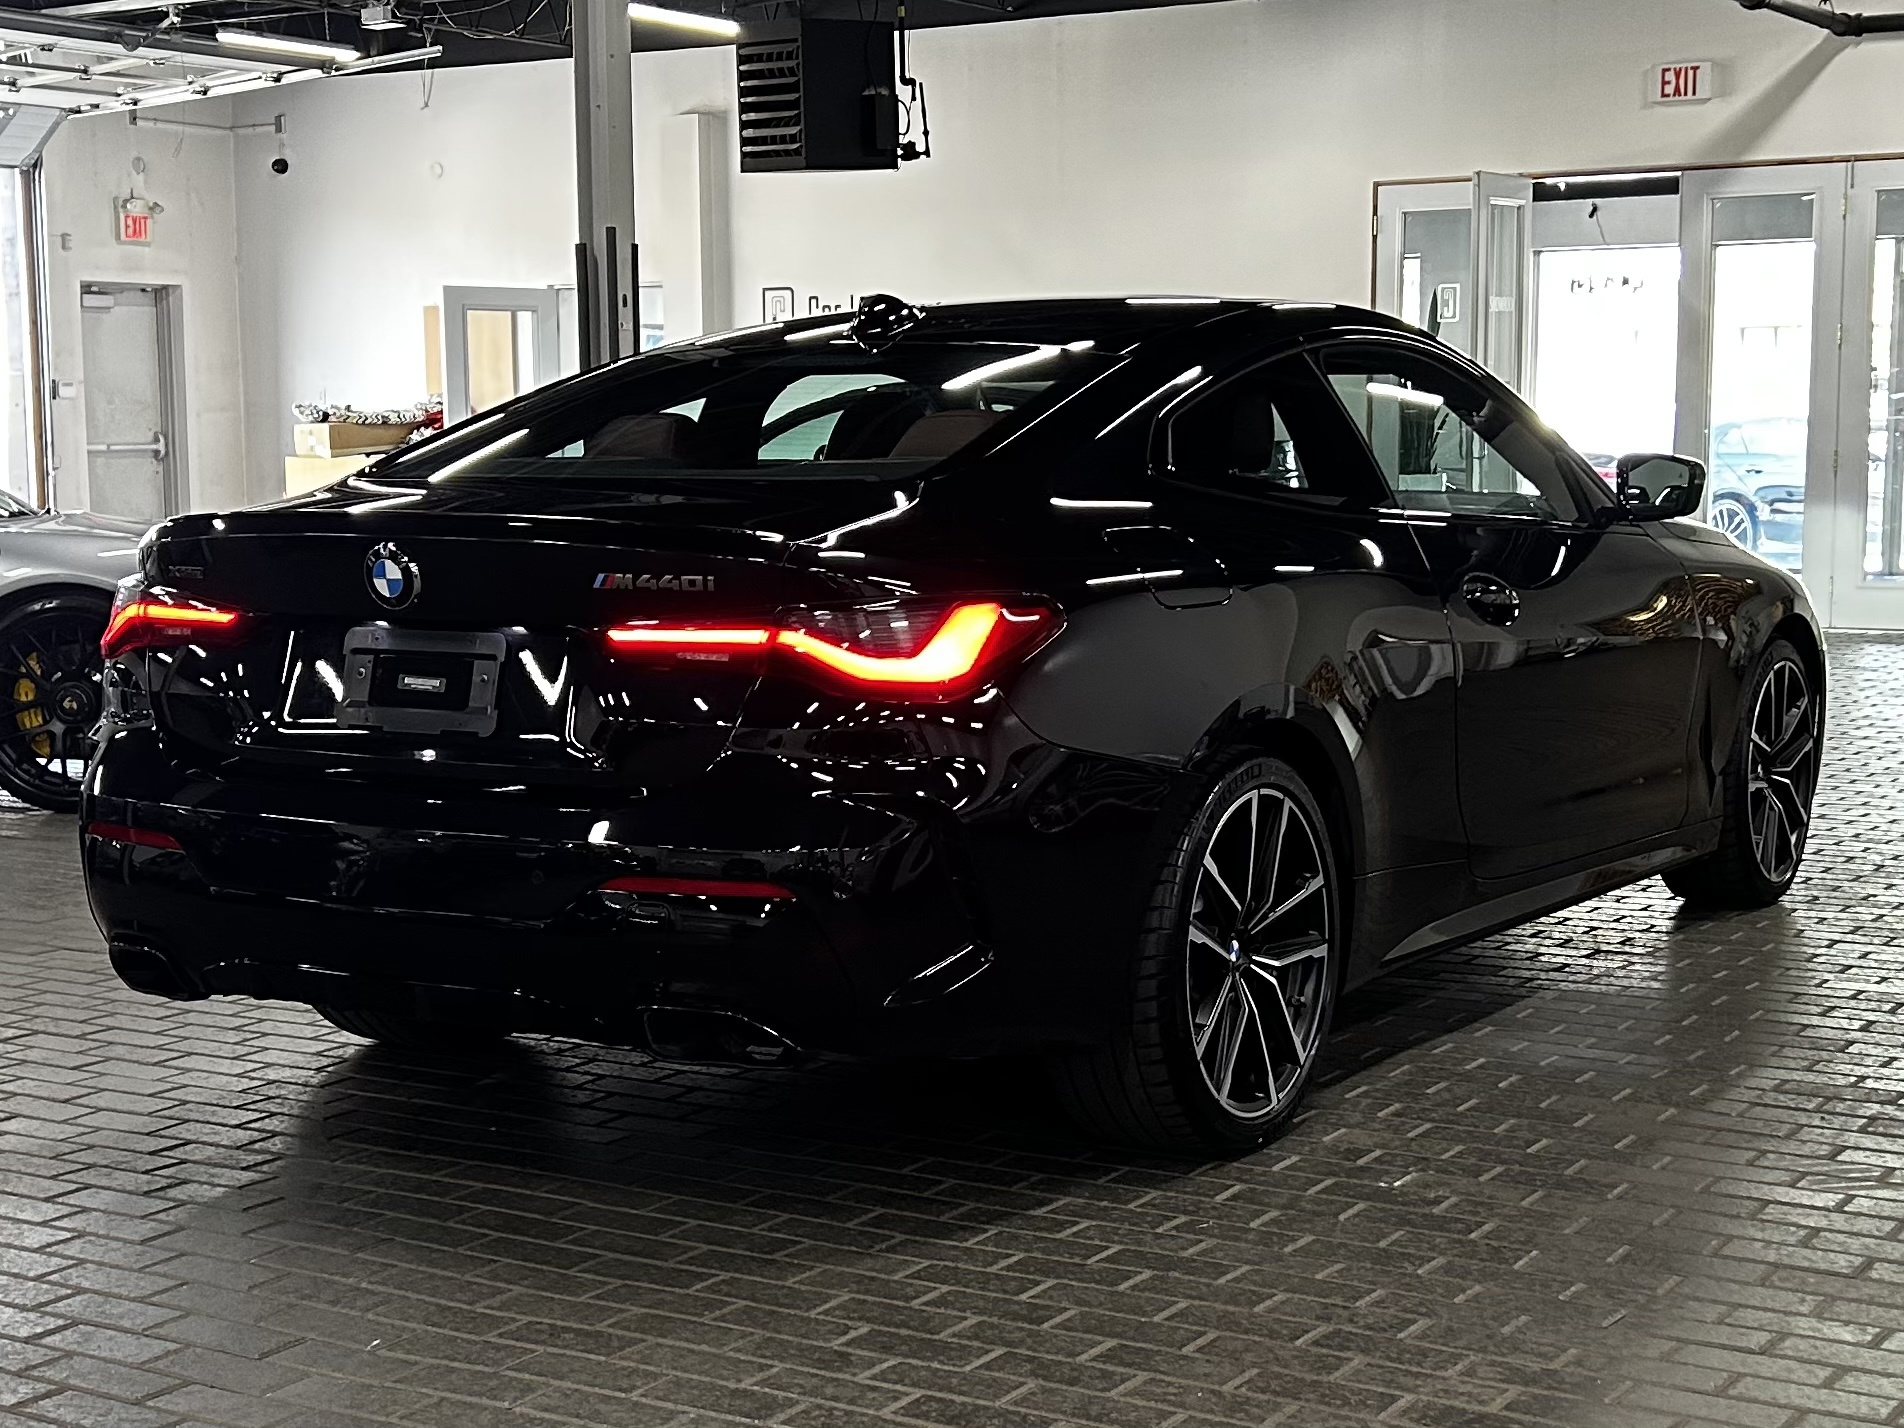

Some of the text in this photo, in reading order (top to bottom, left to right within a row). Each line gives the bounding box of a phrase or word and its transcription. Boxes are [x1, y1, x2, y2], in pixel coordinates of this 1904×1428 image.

[1660, 65, 1700, 98] EXIT
[124, 214, 148, 239] EXIT
[610, 573, 715, 591] M440i
